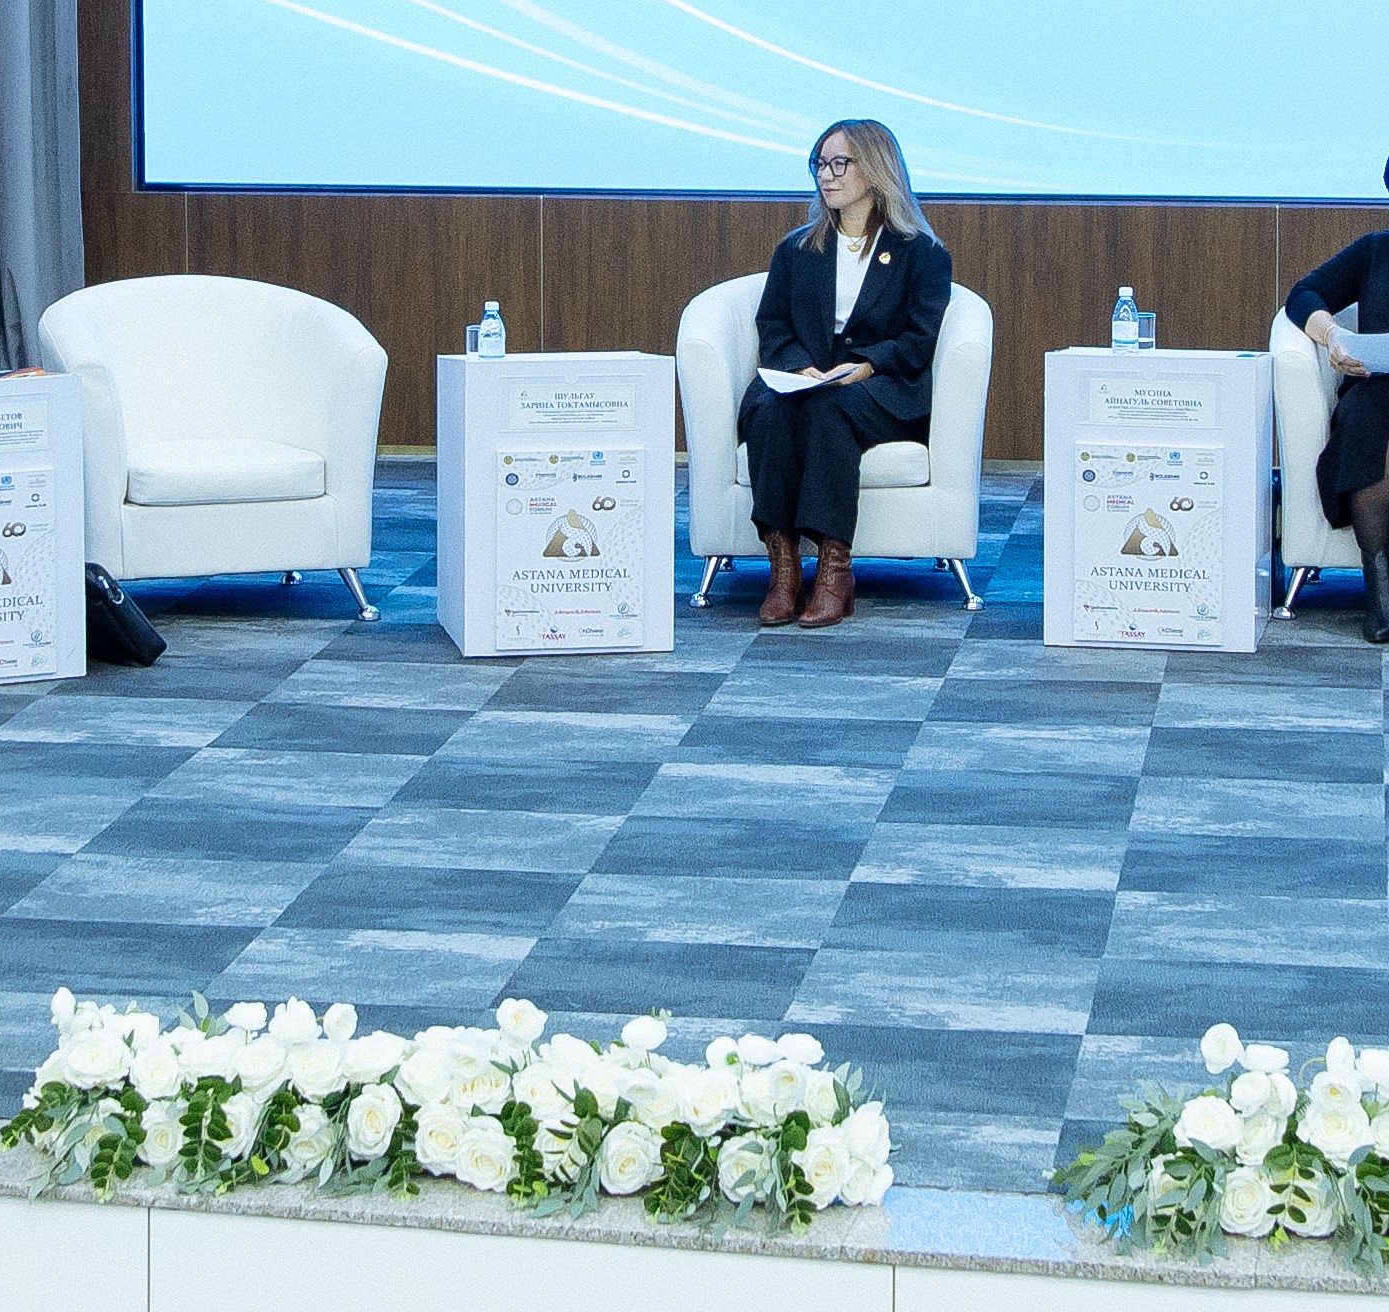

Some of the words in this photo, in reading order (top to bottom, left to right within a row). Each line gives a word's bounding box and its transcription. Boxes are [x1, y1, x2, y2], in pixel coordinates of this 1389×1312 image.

[592, 496, 616, 511] 60
[1170, 496, 1194, 512] 60
[2, 522, 26, 538] 60
[512, 569, 565, 581] ASTANA
[569, 568, 630, 580] MEDICAL
[1090, 566, 1143, 578] ASTANA
[1148, 568, 1210, 580] MEDICAL
[530, 582, 612, 594] UNIVERSITY
[1109, 580, 1192, 593] UNIVERSITY
